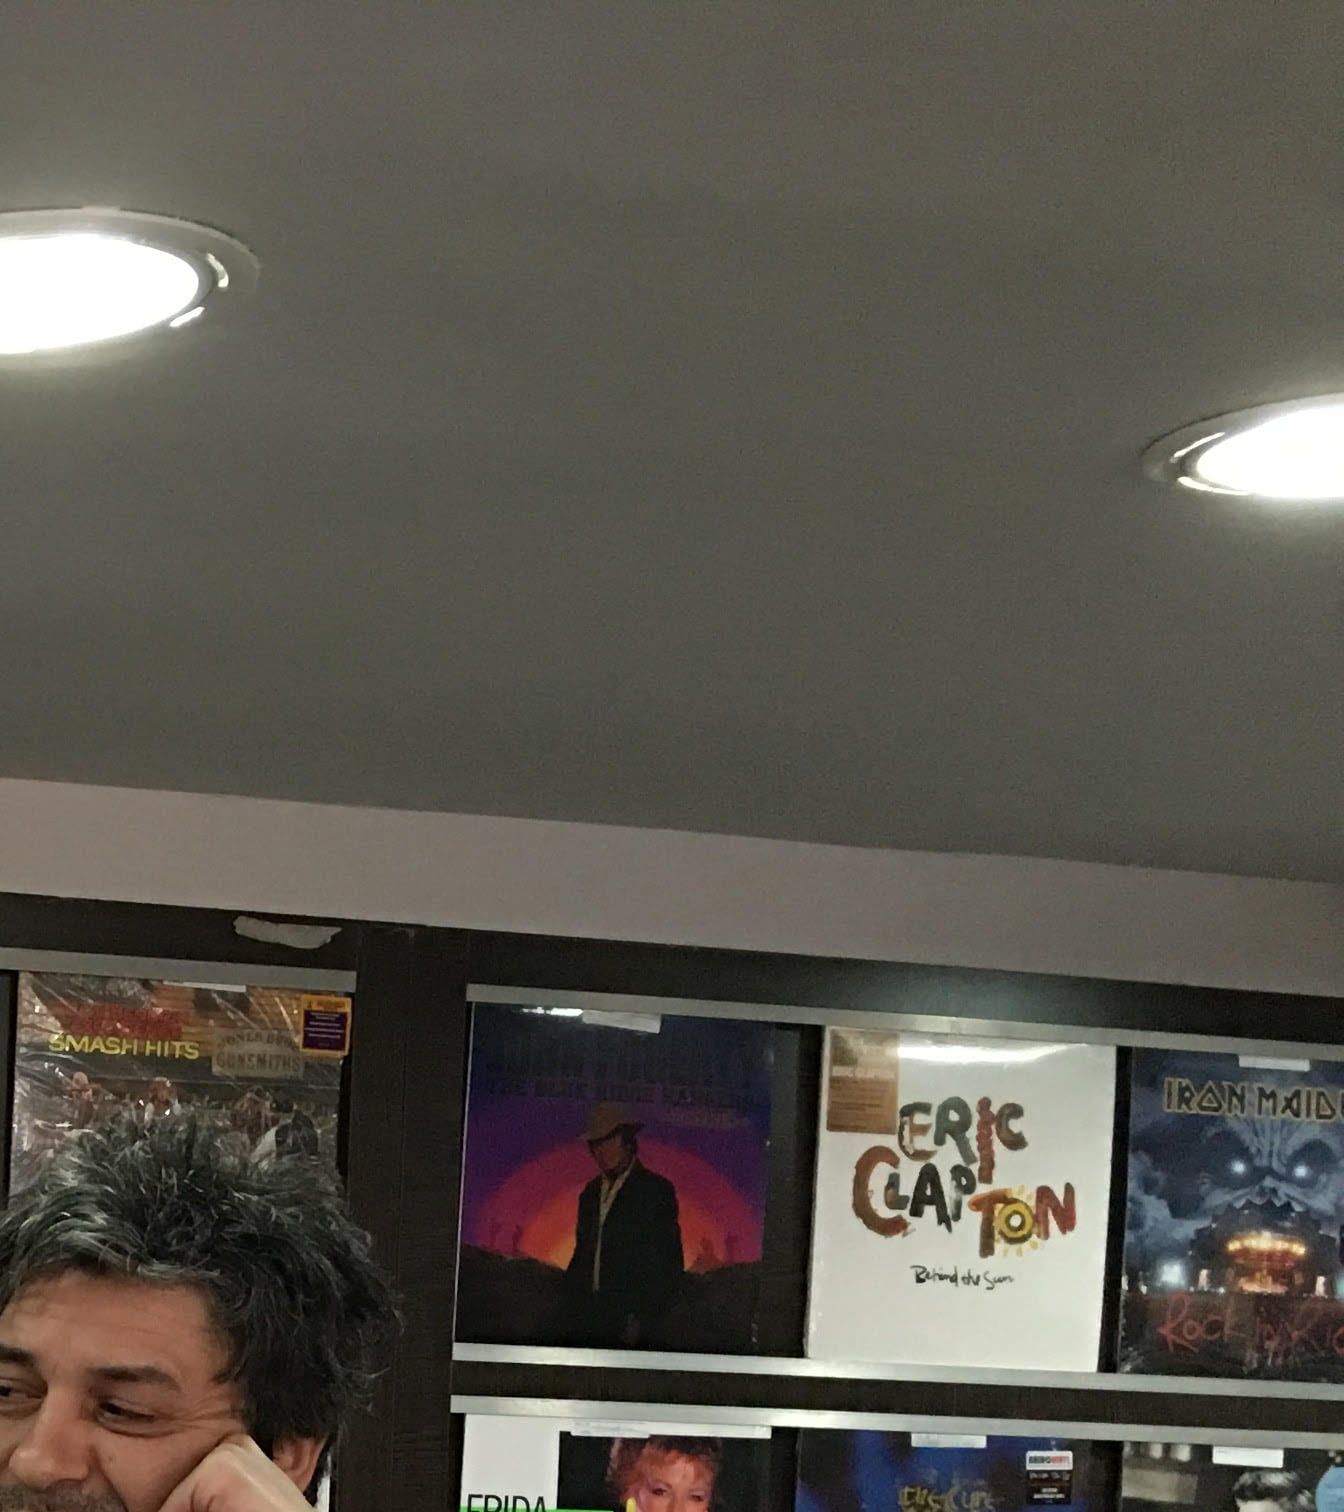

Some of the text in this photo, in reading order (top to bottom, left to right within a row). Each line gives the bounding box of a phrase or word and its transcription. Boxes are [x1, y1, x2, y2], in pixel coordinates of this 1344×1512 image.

[48, 1032, 200, 1061] SMASH HITS
[1164, 1077, 1344, 1122] IRON MAID
[897, 1096, 1030, 1184] ERIC
[910, 1265, 959, 1288] Behind
